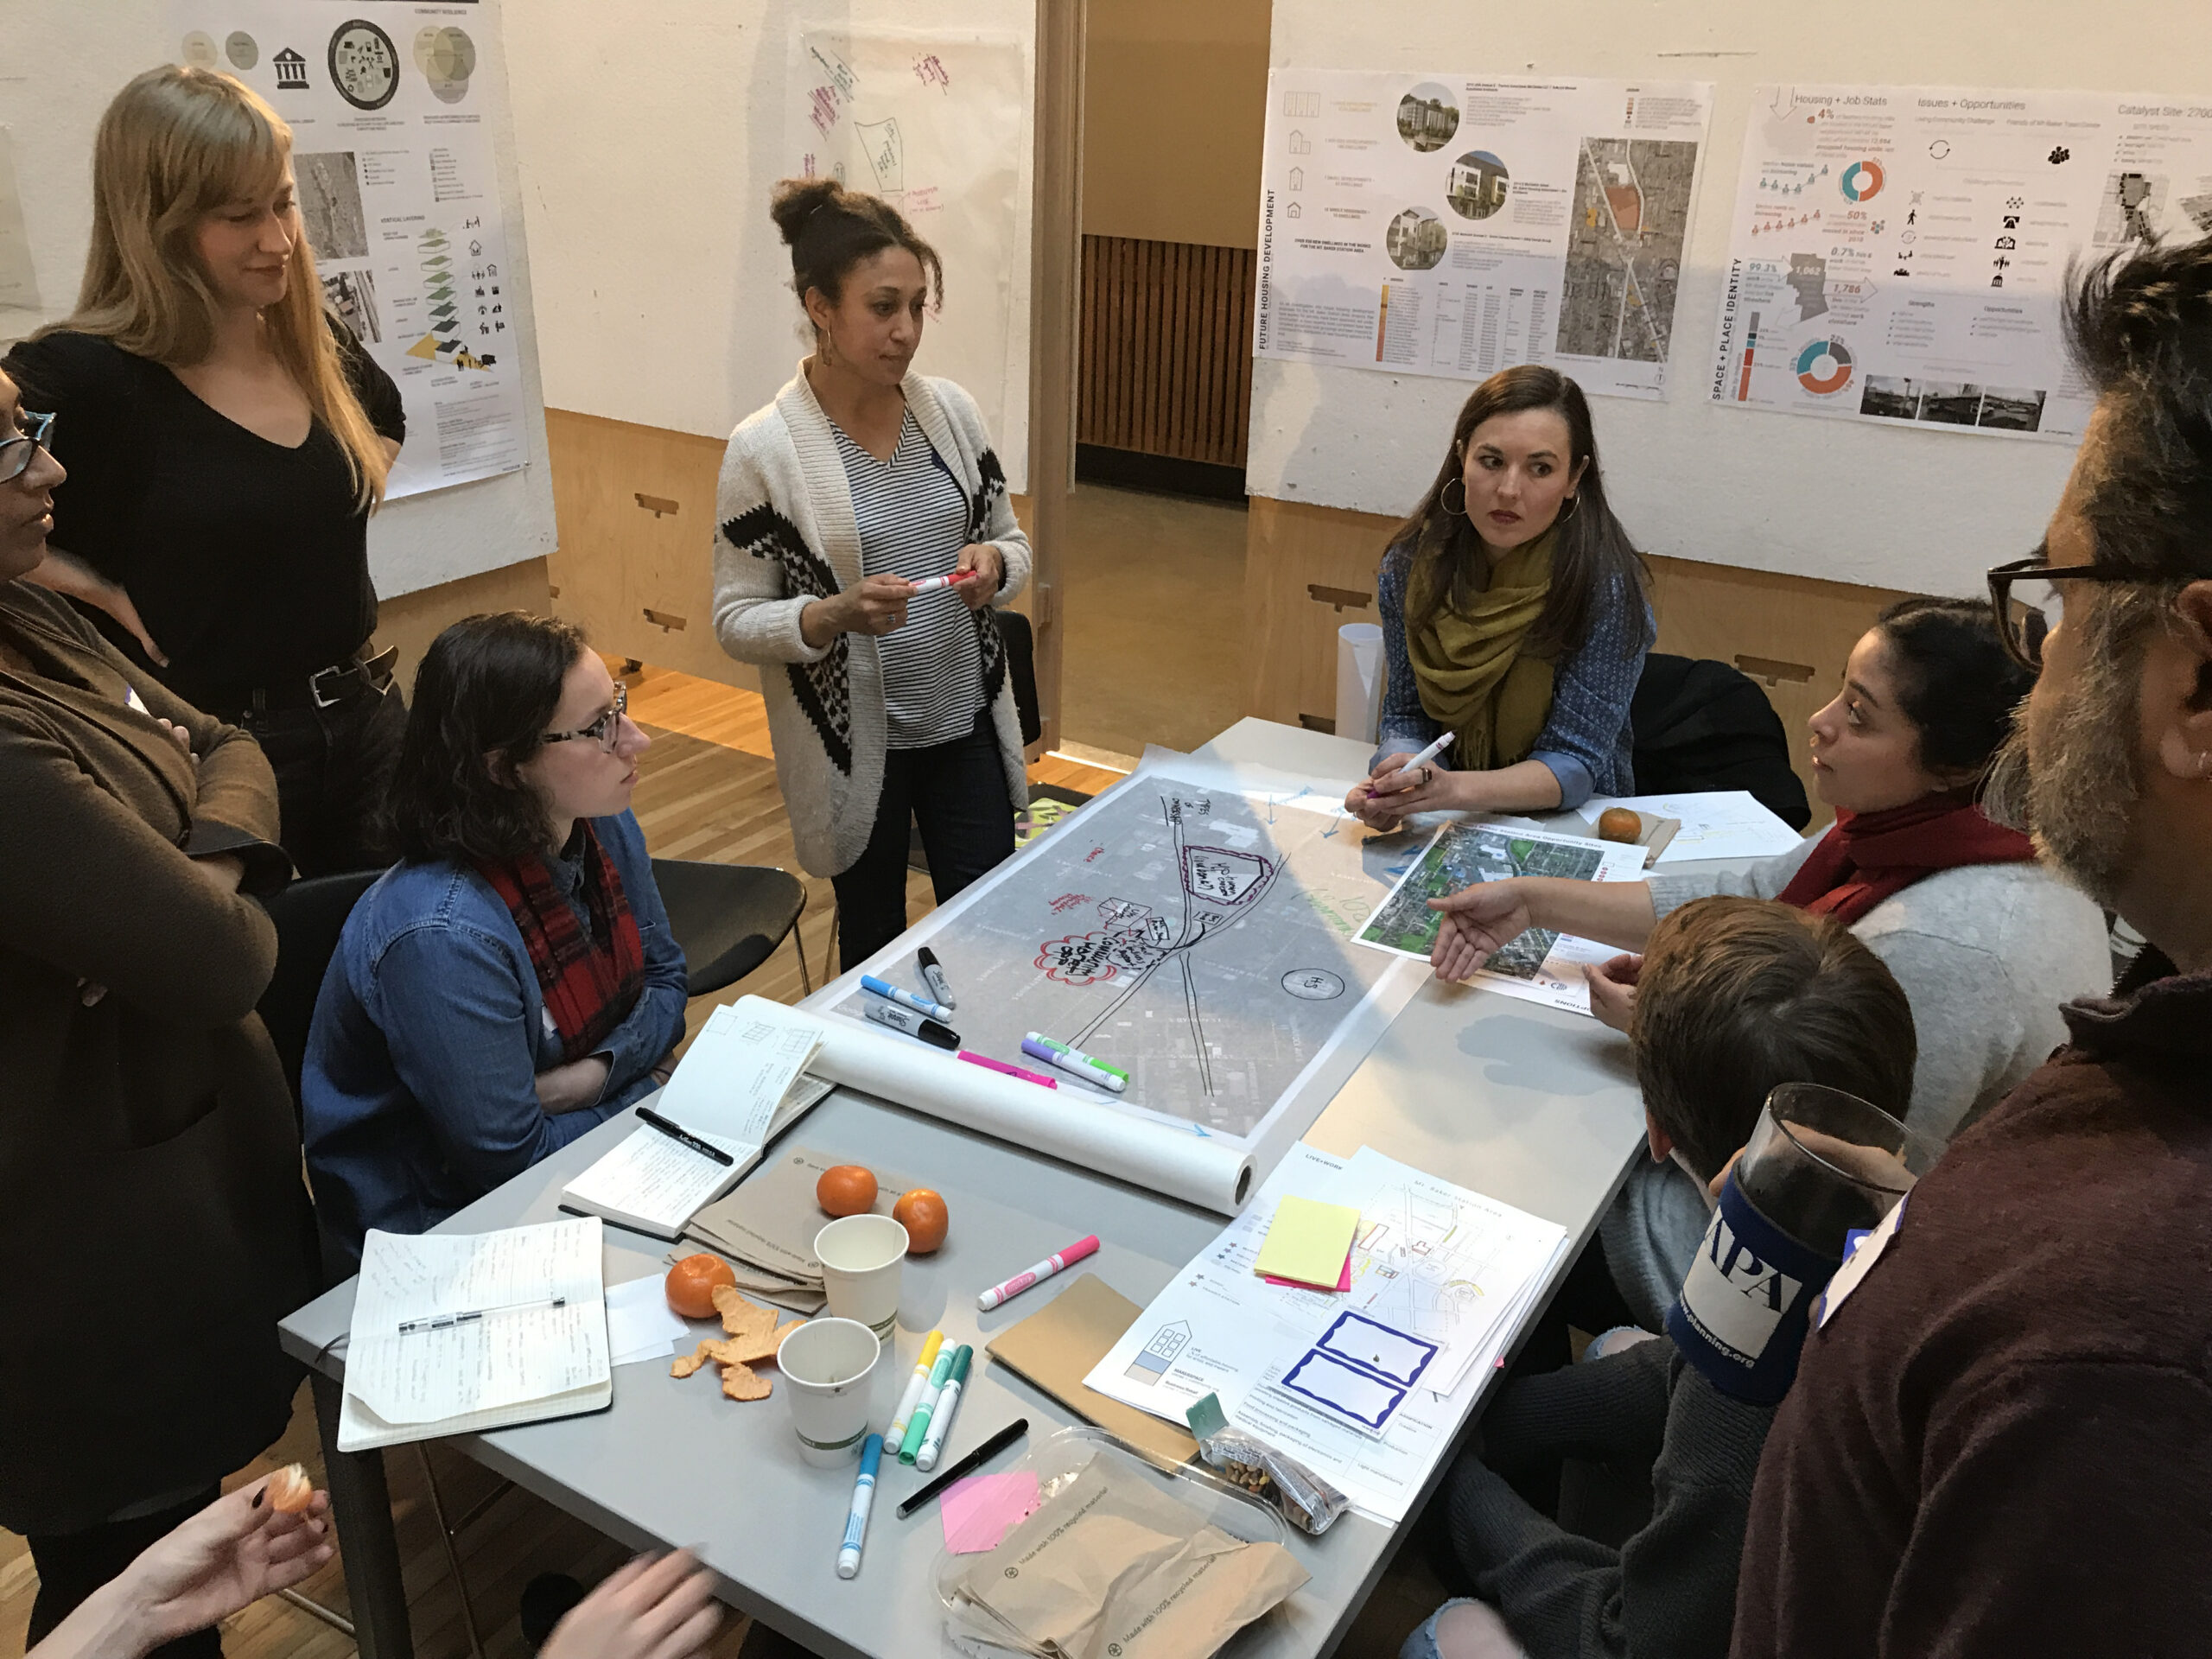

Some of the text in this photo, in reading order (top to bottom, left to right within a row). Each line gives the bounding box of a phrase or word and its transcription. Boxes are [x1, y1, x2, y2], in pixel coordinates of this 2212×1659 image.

[1796, 96, 1832, 106] Housing
[1864, 96, 1887, 105] Stats
[1818, 109, 1834, 119] 4%
[1918, 99, 1948, 107] Issues
[1961, 99, 2025, 111] Opportunities
[2119, 105, 2160, 116] Catalyst
[2163, 107, 2182, 116] Site
[1264, 189, 1274, 262] DEVELOPMENT
[1847, 211, 1866, 220] 50%
[1726, 258, 1743, 312] IDENTITY
[1834, 284, 1860, 294] 1,786
[1720, 315, 1733, 353] PLACE
[1713, 365, 1726, 400] SPACE
[1430, 1186, 1452, 1198] Baker
[1454, 1195, 1482, 1210] Station
[1484, 1208, 1502, 1217] Area
[1705, 1218, 1783, 1314] APA
[1370, 1468, 1403, 1486] manufacturing
[1037, 1540, 1049, 1552] with
[1047, 1527, 1065, 1541] 100%
[1063, 1508, 1086, 1529] recycled
[1122, 1555, 1217, 1643] Made with 100% recycled material
